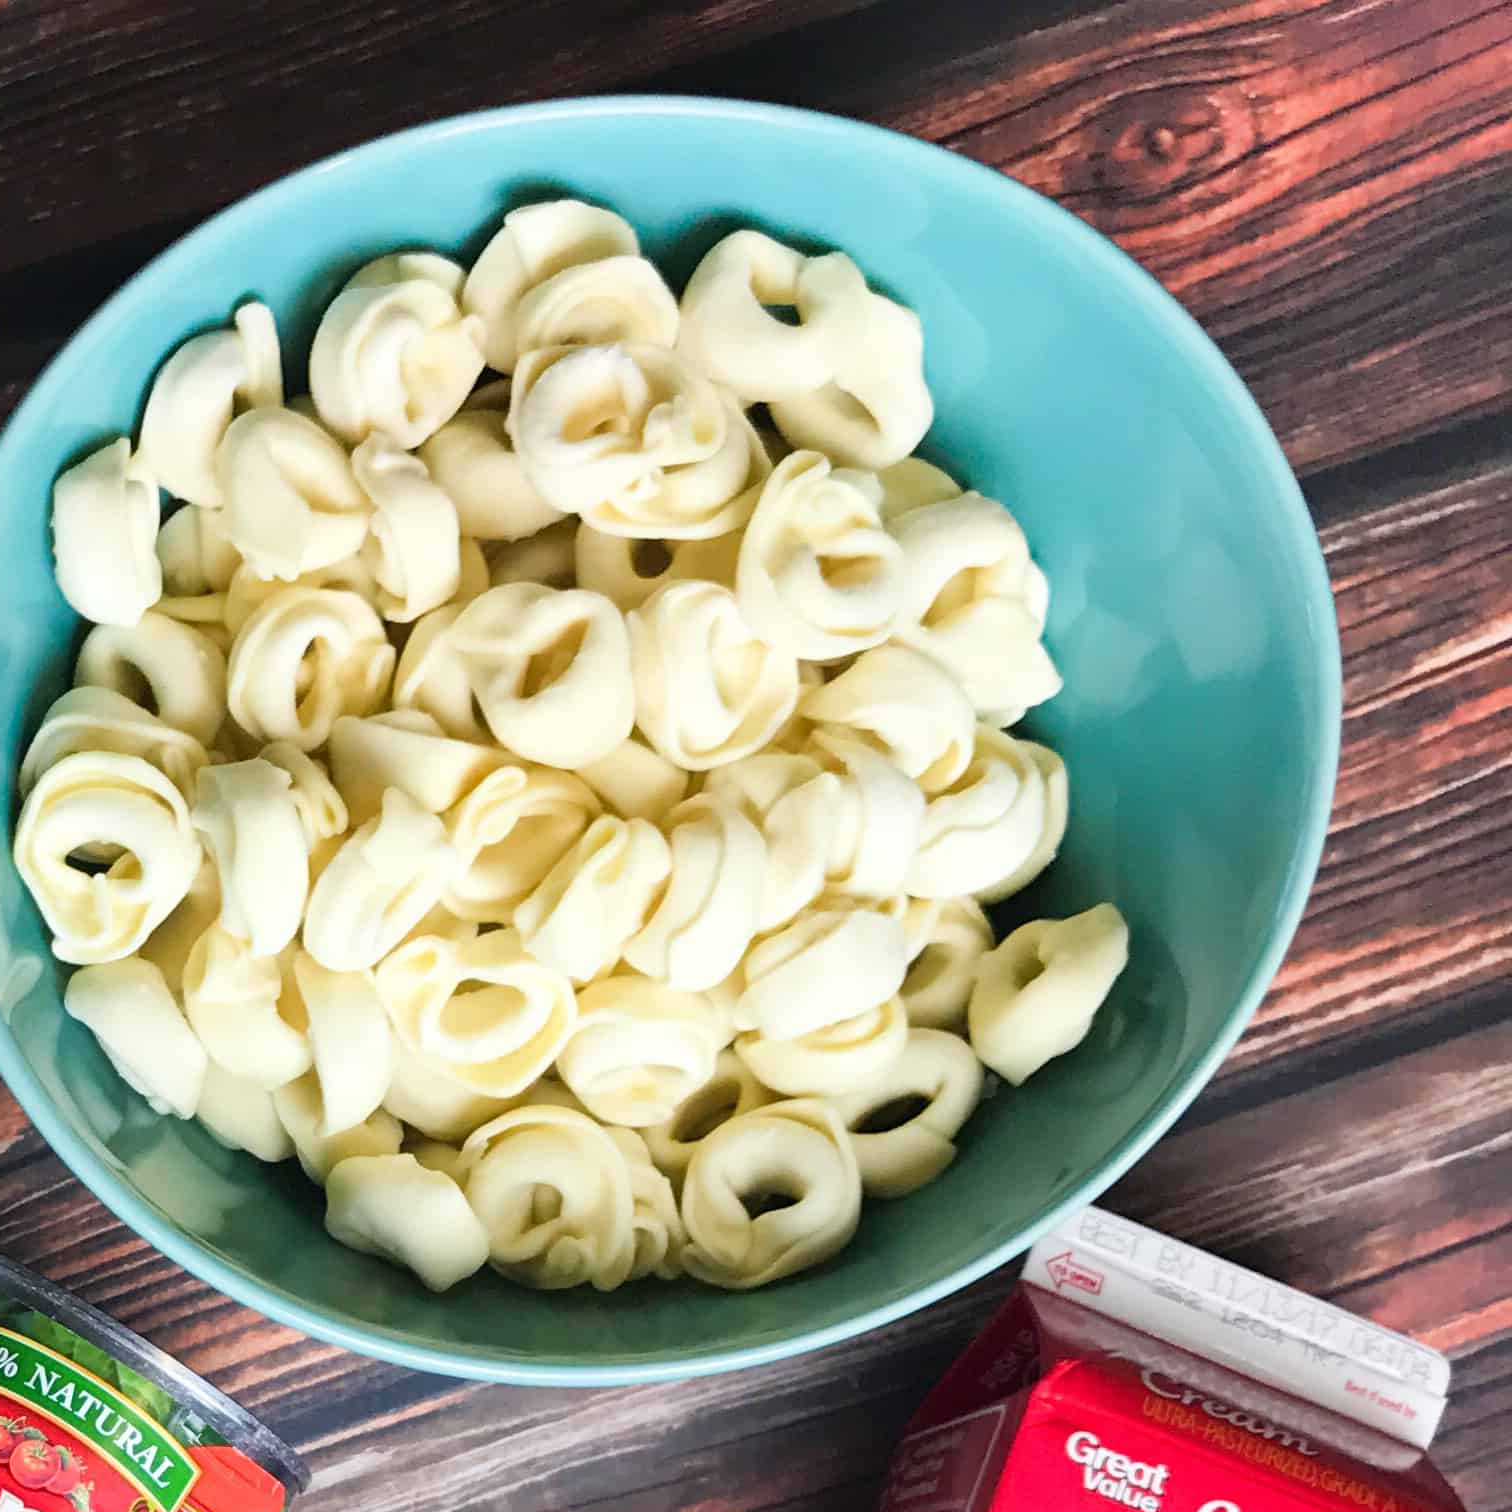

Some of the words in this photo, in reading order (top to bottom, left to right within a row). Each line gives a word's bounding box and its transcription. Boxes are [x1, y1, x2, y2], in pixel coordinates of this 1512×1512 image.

[24, 1363, 176, 1490] NATURAL
[1140, 1366, 1319, 1457] Cream
[1064, 1431, 1170, 1496] Great
